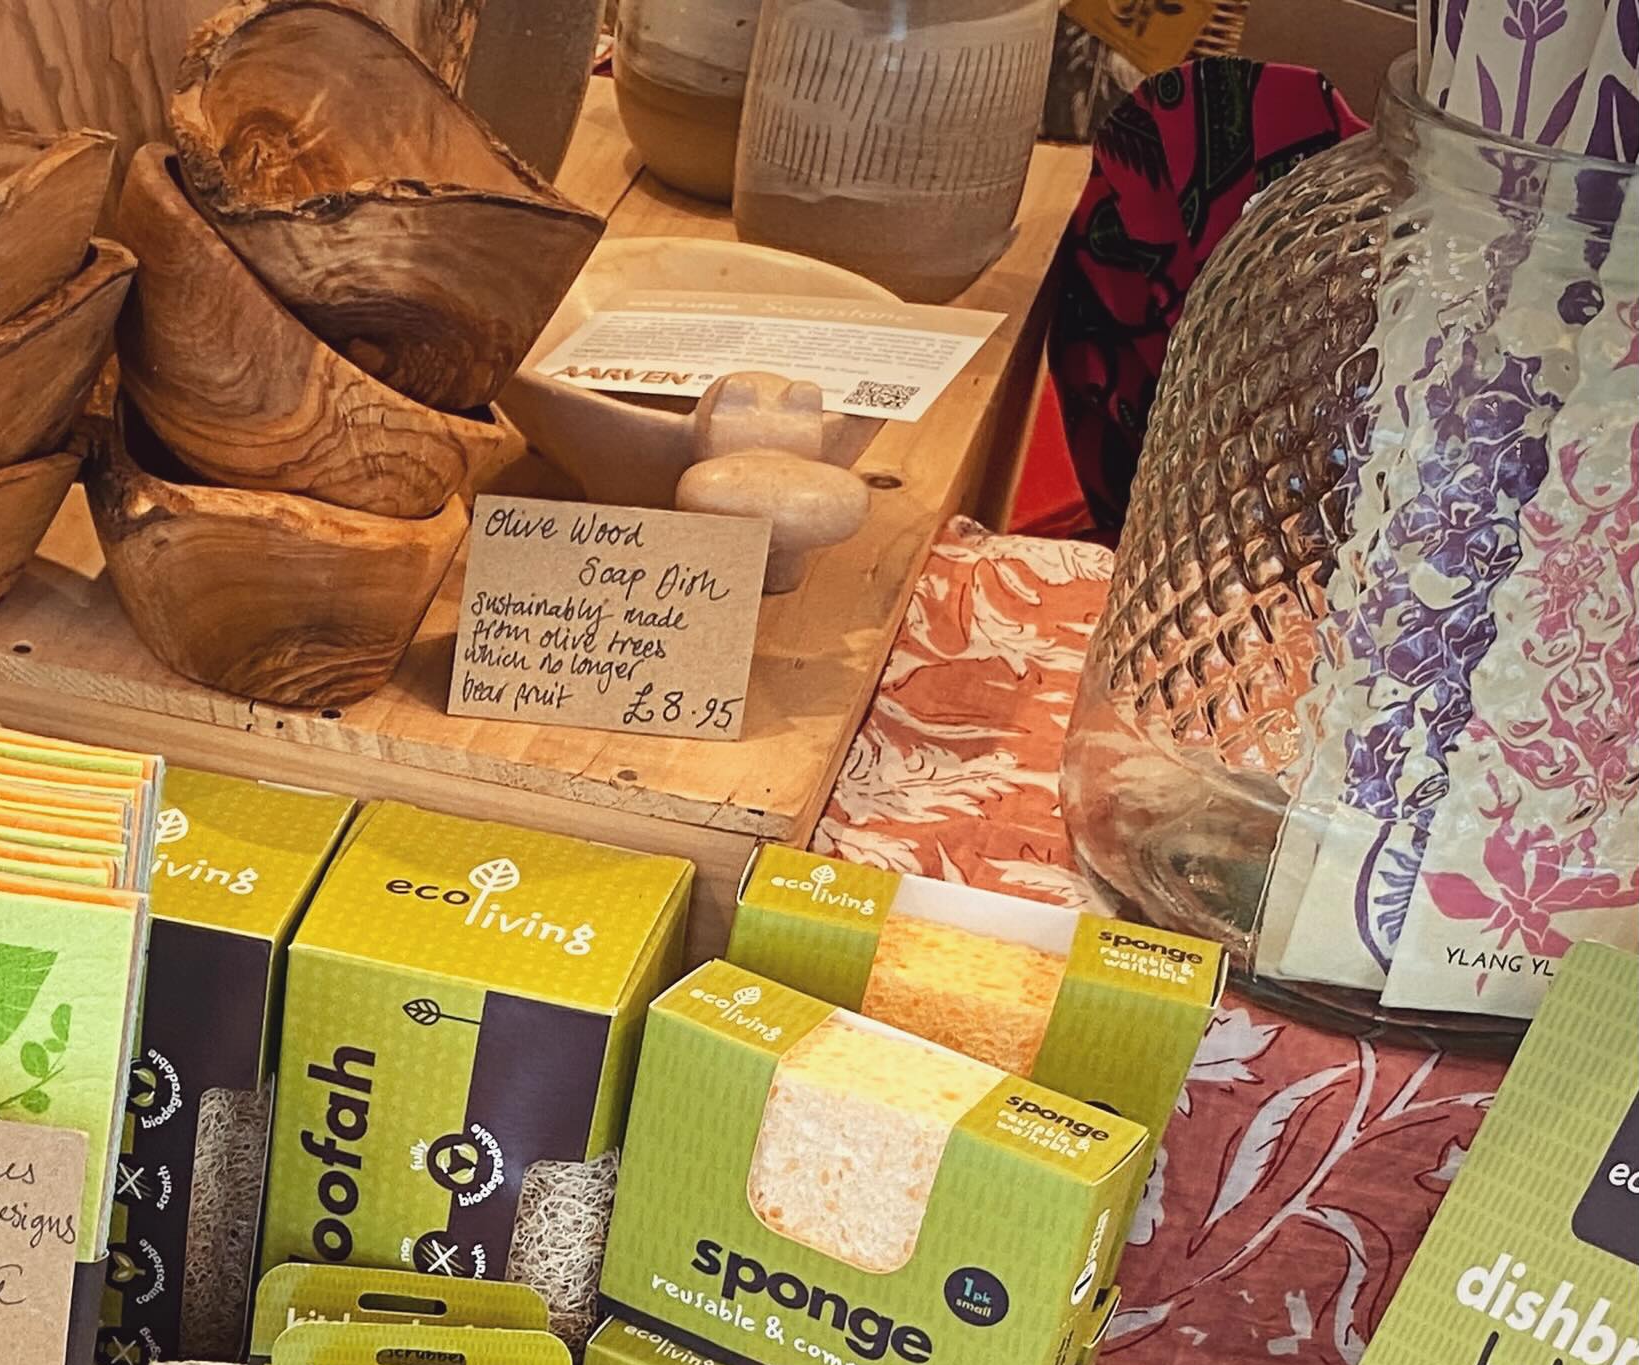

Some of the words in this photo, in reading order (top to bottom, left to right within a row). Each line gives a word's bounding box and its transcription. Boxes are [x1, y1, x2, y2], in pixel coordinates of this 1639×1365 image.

[552, 364, 694, 386] AARVEN
[485, 508, 558, 539] Olive
[569, 512, 645, 548] Wood
[578, 556, 647, 600] Soap
[655, 564, 731, 601] Dish
[470, 590, 613, 634] Sustainably
[623, 605, 690, 631] made
[472, 619, 530, 646] from
[540, 626, 597, 653] olive
[607, 630, 667, 660] trees
[464, 643, 531, 671] which
[540, 655, 564, 674] no
[570, 653, 645, 695] longer
[462, 671, 509, 704] bear
[513, 681, 573, 713] fruit
[384, 879, 471, 906] eco
[465, 890, 598, 956] living
[1098, 929, 1204, 967] sponge
[1445, 946, 1524, 975] YLANG
[458, 1122, 505, 1207] biodegradable
[650, 1273, 757, 1333] reusable
[764, 1315, 786, 1345] &
[690, 1238, 934, 1365] sponge
